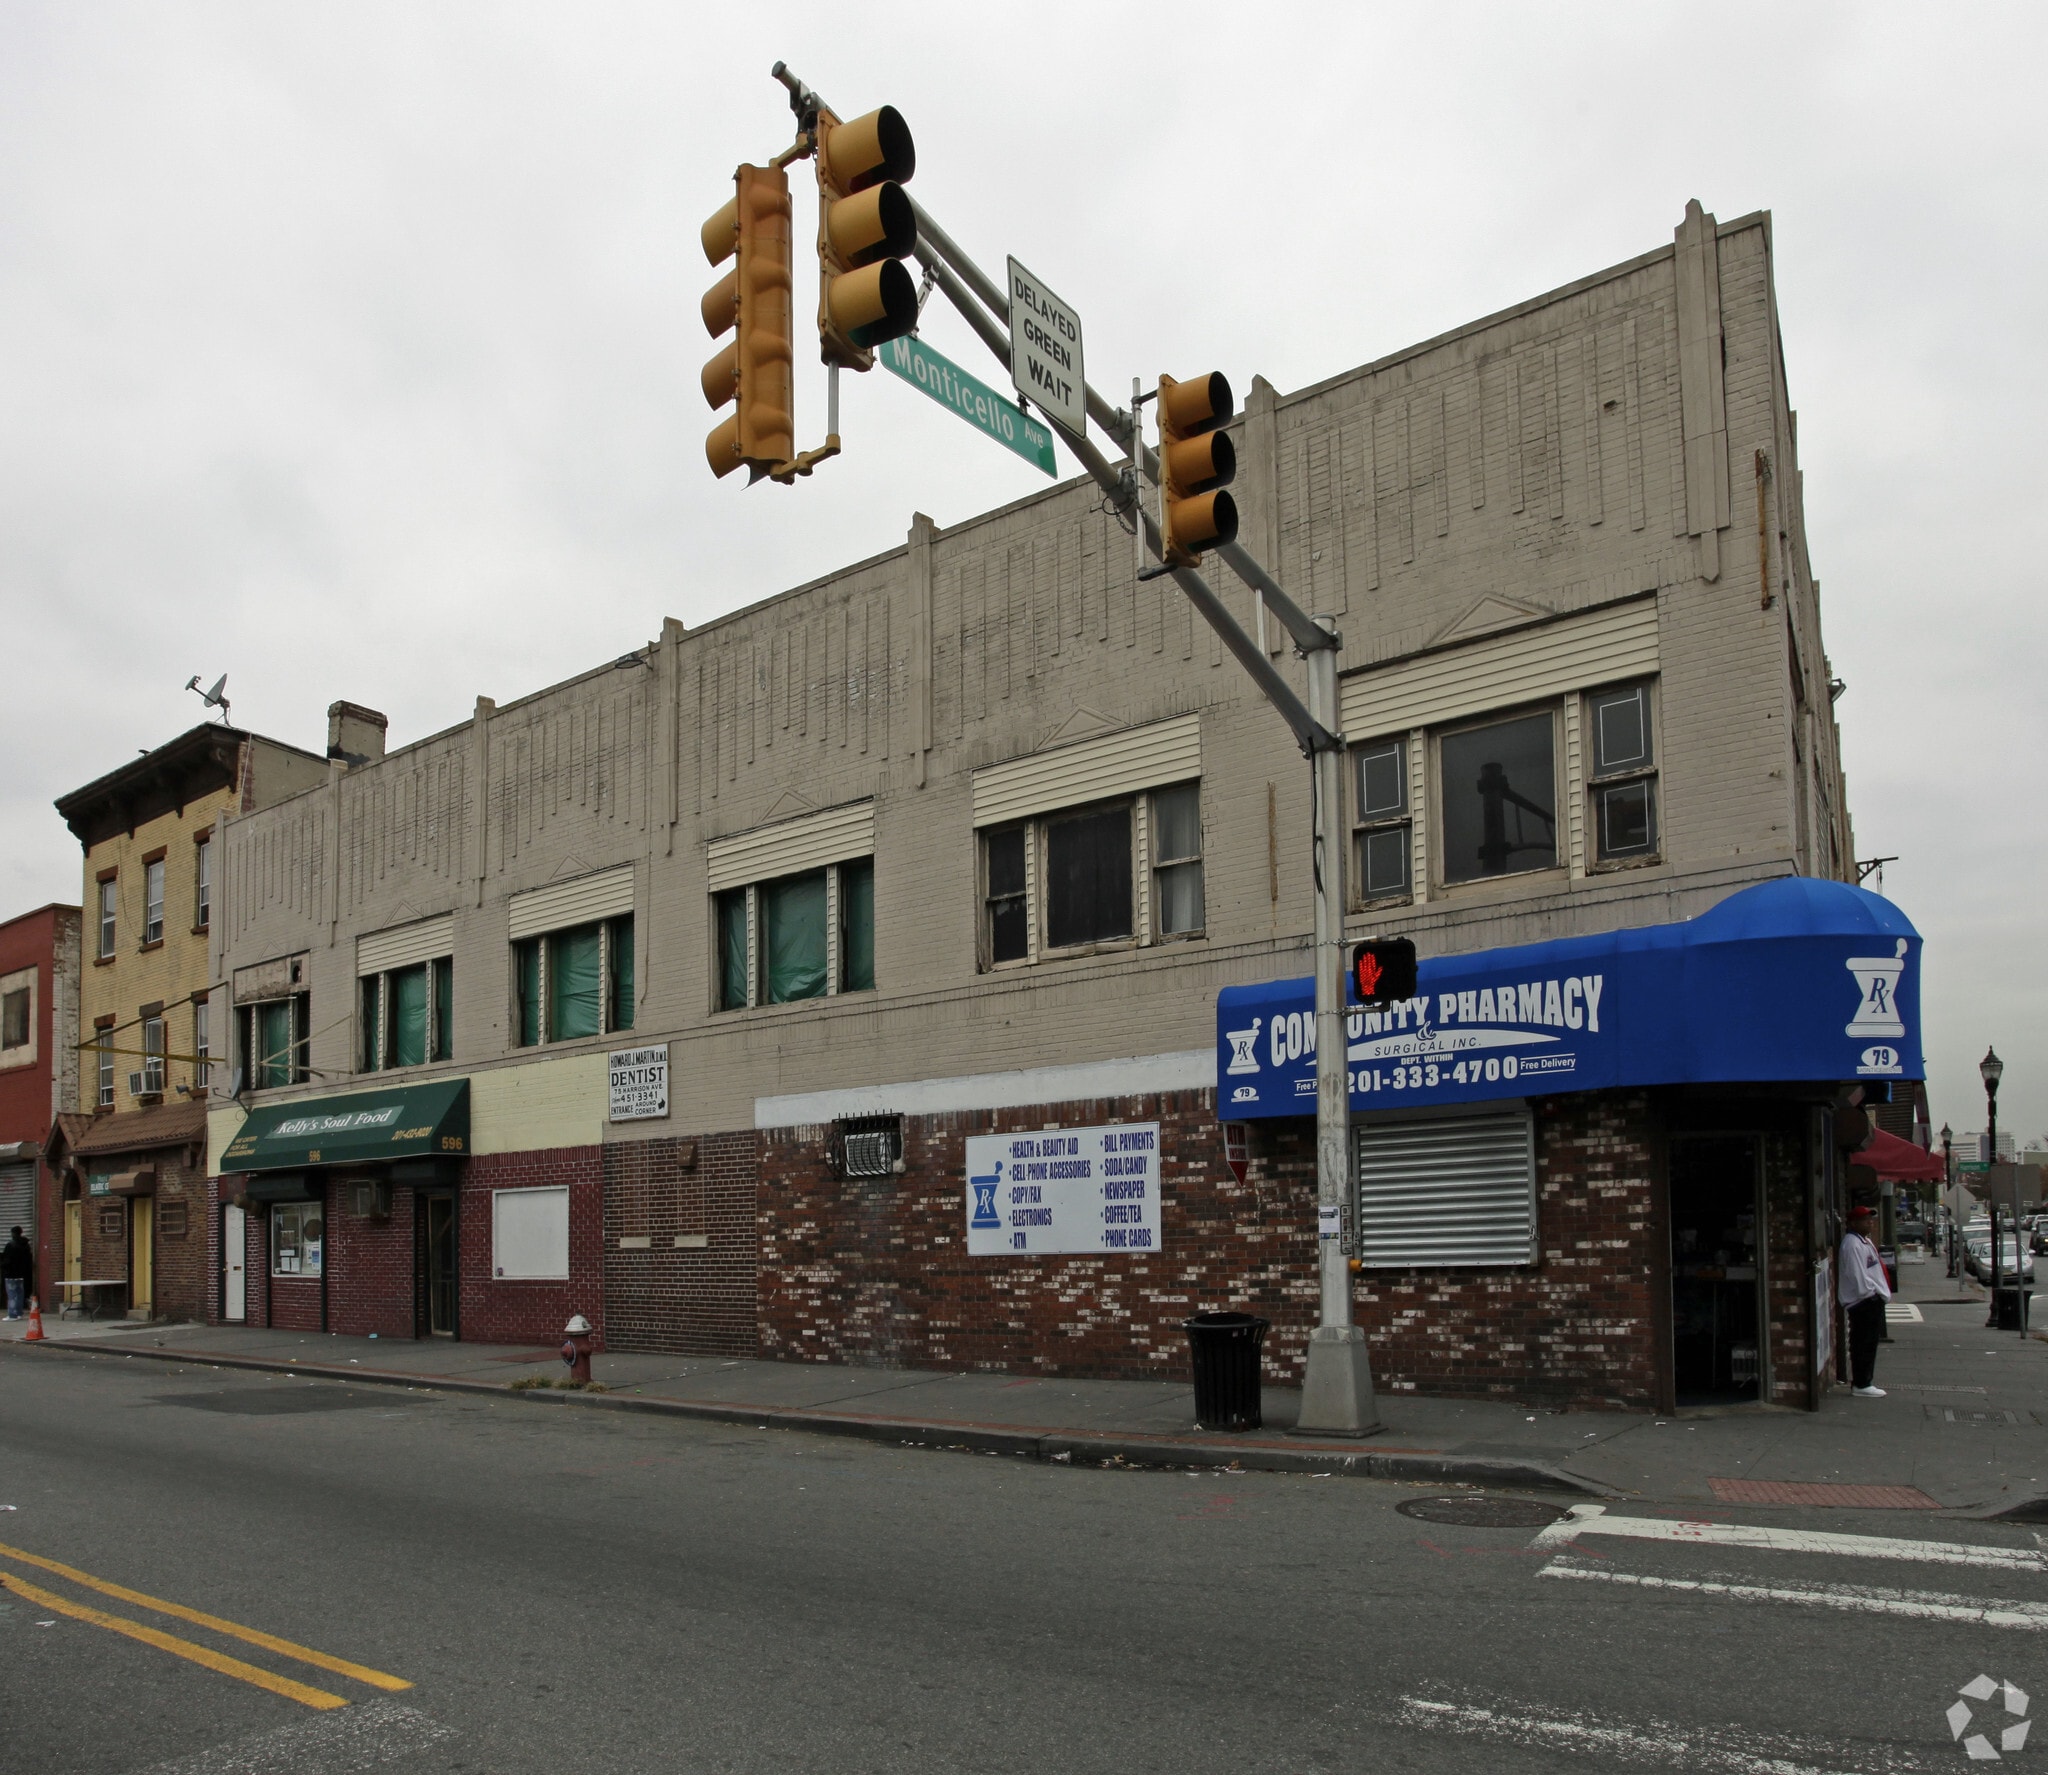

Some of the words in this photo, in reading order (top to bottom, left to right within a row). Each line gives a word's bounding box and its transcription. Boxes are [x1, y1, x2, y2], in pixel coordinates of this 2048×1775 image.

[1014, 275, 1076, 342] DELAYED
[1023, 317, 1071, 372] GREEN
[1027, 354, 1072, 407] WAIT
[892, 337, 1015, 441] Monticello
[1024, 421, 1044, 449] Ave
[1271, 996, 1429, 1067] COMUNITY
[1439, 974, 1603, 1033] PHARMACY
[1416, 1020, 1437, 1042] &
[1374, 1037, 1444, 1057] SURGICAL
[1452, 1036, 1482, 1049] INC.
[1400, 1056, 1422, 1066] DEPT.
[1423, 1052, 1454, 1063] WITHIN
[1520, 1059, 1540, 1071] Free
[1541, 1056, 1577, 1070] Delivery
[1872, 1048, 1890, 1066] 79
[611, 1066, 664, 1086] DENTIST
[1347, 1055, 1518, 1094] 201-333-4700
[622, 1085, 650, 1093] HARRISON
[1239, 1088, 1250, 1098] 79
[1296, 1082, 1312, 1092] Free
[611, 1105, 633, 1116] ENTRANCE
[635, 1100, 657, 1108] AROUND
[635, 1107, 657, 1116] CORNER
[277, 1117, 318, 1135] Kelly's
[321, 1115, 351, 1129] Soul
[353, 1109, 392, 1126] Food
[441, 1137, 463, 1150] 596
[1012, 1140, 1035, 1159] HEALTH
[1035, 1143, 1041, 1158] &
[1042, 1138, 1066, 1157] BEAUTY
[1067, 1137, 1079, 1155] AID
[1104, 1133, 1118, 1153] BILL
[1119, 1131, 1154, 1151] PAYMENTS
[309, 1150, 321, 1162] 596
[1012, 1164, 1027, 1181] CELL
[1027, 1163, 1048, 1180] PHONE
[1049, 1160, 1091, 1180] ACCESSORIES
[1104, 1156, 1147, 1177] SODA/CANDY
[1012, 1186, 1042, 1205] COPY/FAX
[1104, 1180, 1145, 1201] NEWSPAPER
[1012, 1208, 1052, 1227] ELECTRONICS
[1105, 1204, 1142, 1224] COFFEE/TEA
[1013, 1232, 1027, 1250] ATM
[1105, 1230, 1127, 1248] PHONE
[1128, 1228, 1152, 1247] CARDS
